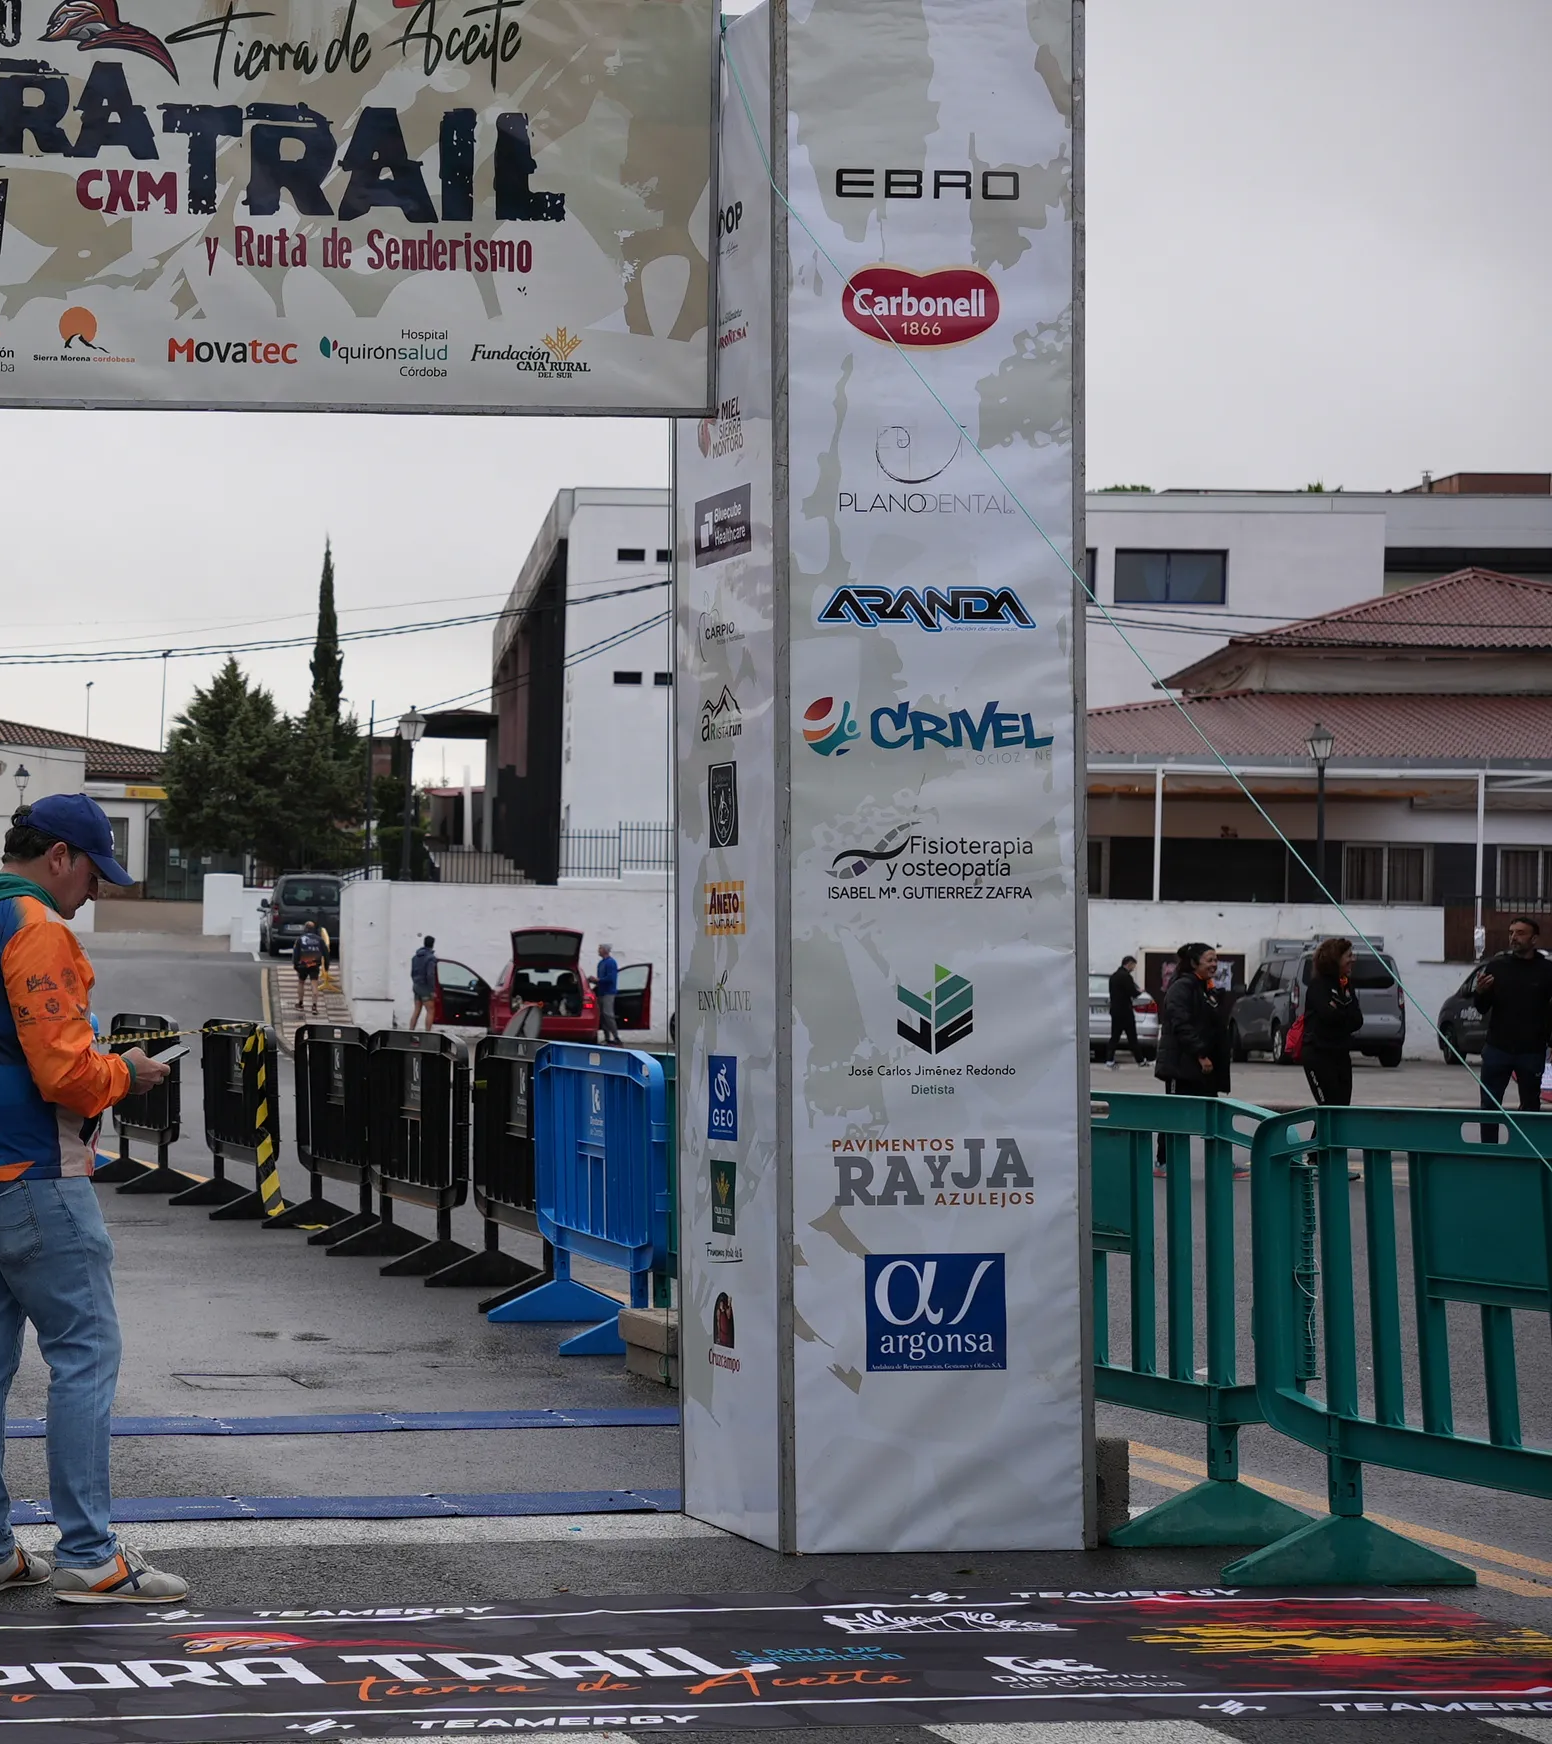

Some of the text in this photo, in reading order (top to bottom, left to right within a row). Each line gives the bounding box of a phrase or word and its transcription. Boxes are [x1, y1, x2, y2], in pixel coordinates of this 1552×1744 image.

[165, 0, 525, 90] Tierra de Aceite
[162, 103, 565, 223] TRAIL
[75, 168, 178, 215] CXM
[836, 168, 1020, 200] EBRO
[205, 225, 533, 276] y Ruta de Senderismo
[853, 287, 986, 318] Carbonell
[401, 328, 448, 341] Hospital
[901, 321, 942, 336] 1866
[33, 354, 58, 362] Sierra
[92, 355, 136, 363] cordobesa
[168, 337, 298, 365] Movatec
[337, 343, 448, 364] quirónsalud
[470, 343, 550, 367] Fundación
[399, 365, 448, 378] Córdoba
[516, 361, 591, 373] CAJA RURAL
[721, 396, 741, 420] MIEL
[718, 417, 742, 440] SIERRA
[712, 433, 744, 459] MONTORO
[714, 501, 742, 523] Bluecube
[715, 524, 746, 546] Healthcare
[818, 585, 1036, 632] ARANDA
[705, 621, 735, 640] CARPIO
[870, 701, 1054, 751] CRIVEL
[975, 750, 1052, 765] OCIOZNE
[910, 835, 1033, 858] Fisioterapia
[886, 858, 1011, 881] y osteopatía
[709, 887, 739, 915] ANETO
[828, 887, 876, 899] ISABEL
[903, 886, 983, 899] GUTIERREZ
[985, 886, 1033, 899] ZAFRA
[848, 1064, 1016, 1078] José Carlos Jiménez Redondo
[910, 1084, 955, 1096] Dietista
[713, 1108, 734, 1127] GEO
[832, 1139, 954, 1152] PAVIMENTOS
[834, 1138, 1034, 1206] RAYJA
[934, 1192, 1035, 1208] AZULEJOS
[880, 1332, 994, 1361] argonsa
[708, 1348, 740, 1374] Cruzcampo
[253, 1605, 495, 1619] TEAMERGY
[343, 1646, 781, 1683] TRAIL
[576, 1673, 642, 1693] de
[683, 1669, 913, 1697] Aceite
[1319, 1701, 1552, 1713] TEAMER
[412, 1715, 699, 1732] TEAMERGY
